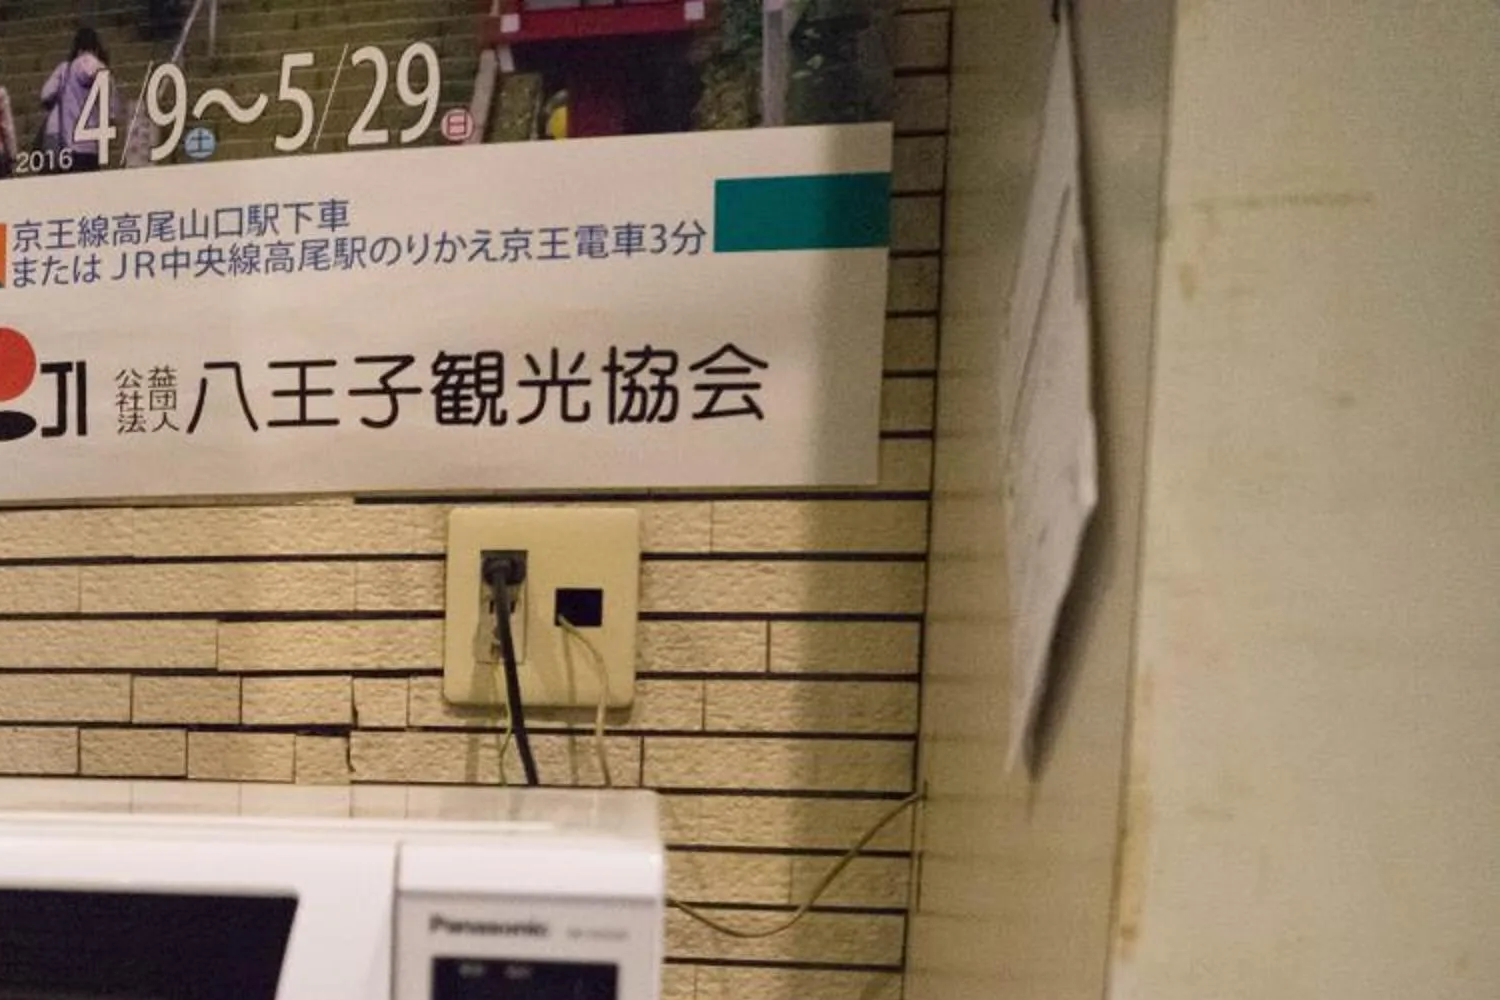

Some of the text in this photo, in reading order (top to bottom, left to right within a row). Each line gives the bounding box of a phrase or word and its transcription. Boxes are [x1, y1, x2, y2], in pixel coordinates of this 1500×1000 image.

[14, 148, 74, 174] 2016
[11, 198, 350, 253] 京王線高尾山口駅下車
[186, 341, 770, 435] 八王子観光協会
[428, 913, 550, 938] Panasonic
